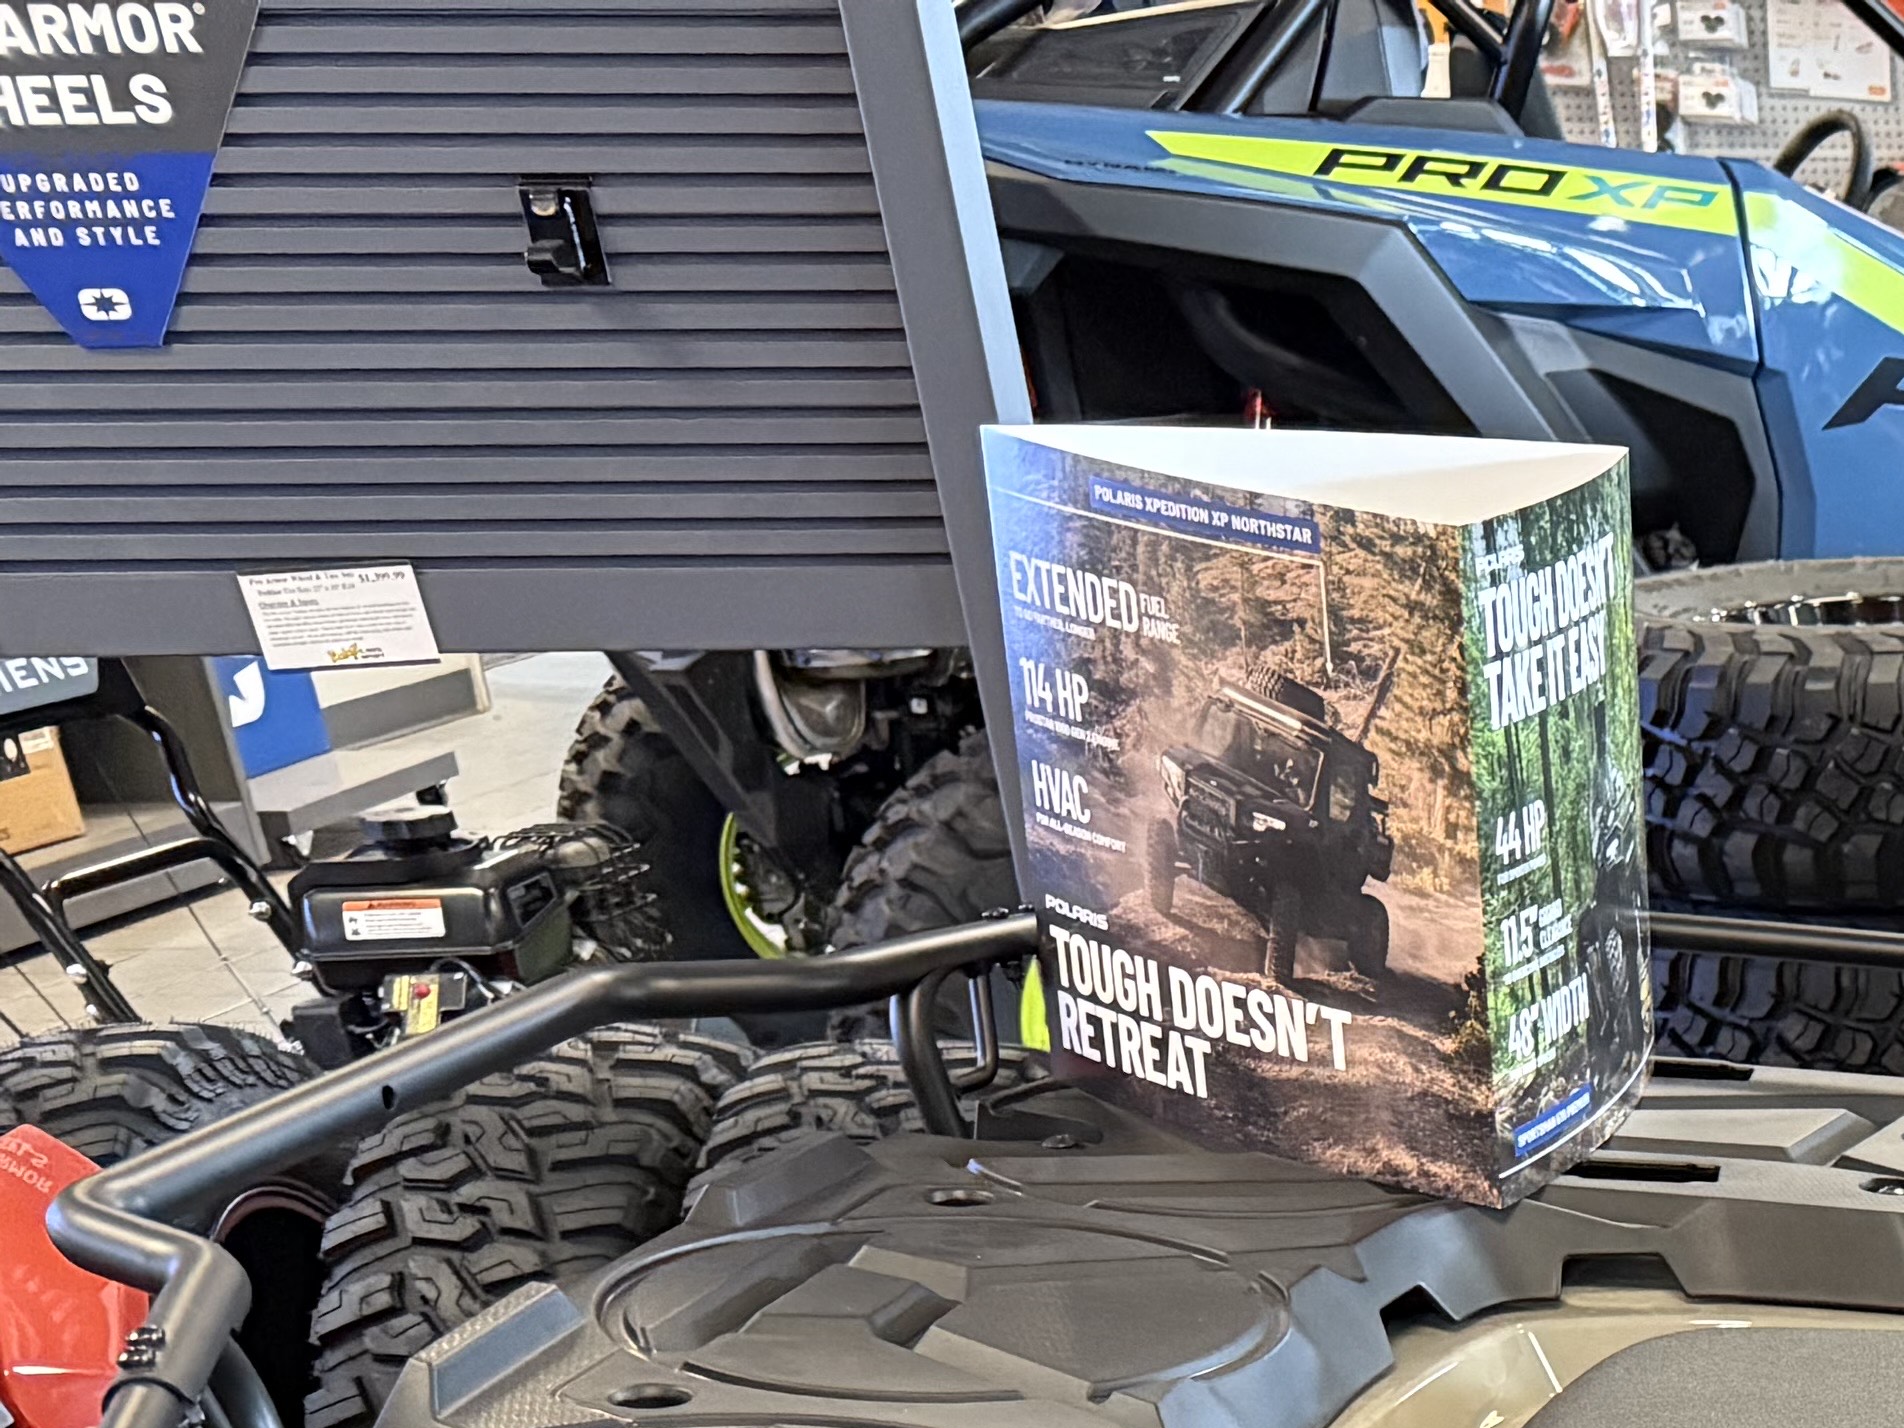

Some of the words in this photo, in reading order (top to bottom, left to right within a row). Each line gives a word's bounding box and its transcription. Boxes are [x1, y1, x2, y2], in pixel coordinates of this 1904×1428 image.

[0, 73, 174, 125] HEELS
[0, 172, 140, 194] UPGRADED
[0, 199, 176, 221] ERFORMANCE
[1312, 147, 1569, 198] PRO
[1566, 174, 1719, 210] XP
[14, 227, 65, 247] AND
[75, 225, 161, 247] STYLE
[1094, 484, 1143, 512] POLARIS
[1144, 497, 1209, 524] XPEDITION
[1211, 511, 1230, 528] XP
[1231, 515, 1313, 545] NORTHSTAR
[1009, 551, 1140, 634] EXTENDED
[1140, 592, 1170, 619] FUEL
[1477, 565, 1556, 659] TOUGH
[1142, 615, 1182, 646] RANGE
[0, 656, 89, 693] IENS
[1019, 656, 1053, 713] 114
[1055, 667, 1089, 722] HP
[1483, 643, 1547, 731] TAKE
[1546, 633, 1566, 707] IT
[1567, 609, 1607, 695] EASY
[1031, 759, 1091, 824] HVAC
[1495, 810, 1522, 865] 44
[1522, 798, 1546, 856] HP
[1045, 893, 1109, 931] POLARIS
[1049, 924, 1164, 1022] TOUGH
[1168, 966, 1352, 1072] DOESN'T
[1540, 971, 1590, 1047] WIDTH
[1057, 989, 1212, 1099] RETREAT
